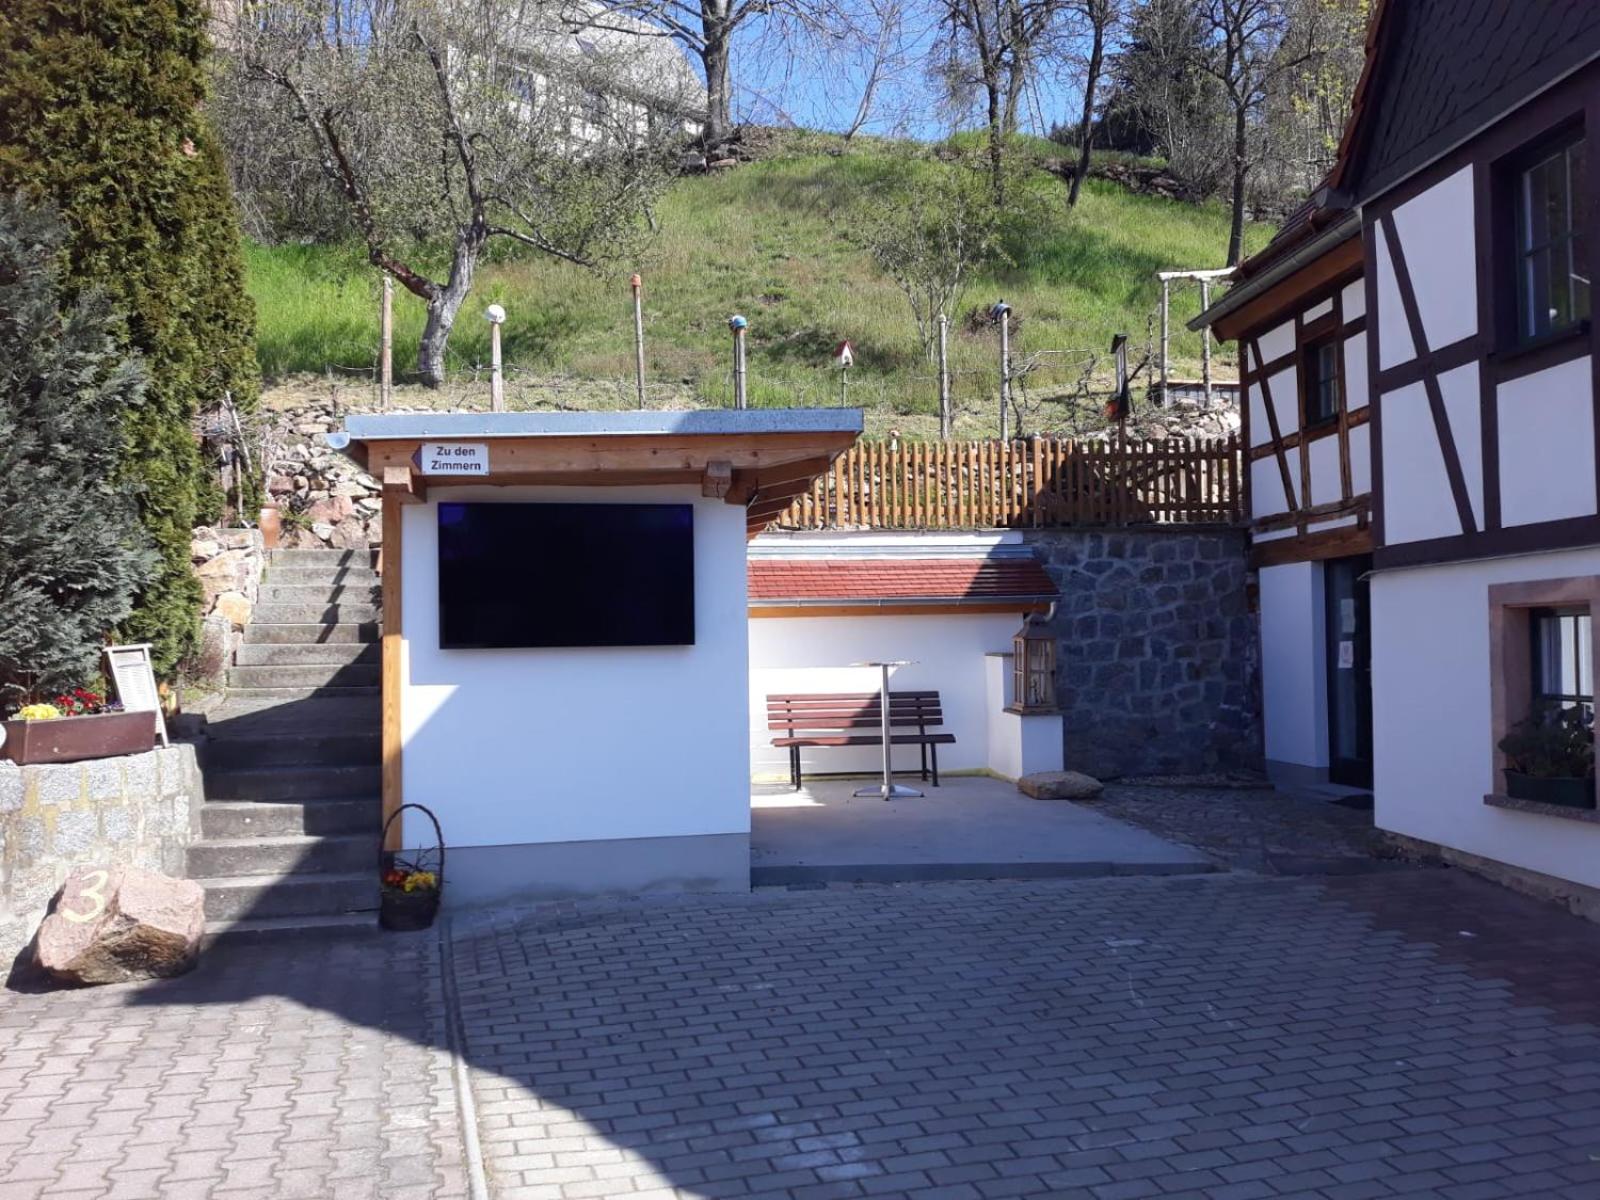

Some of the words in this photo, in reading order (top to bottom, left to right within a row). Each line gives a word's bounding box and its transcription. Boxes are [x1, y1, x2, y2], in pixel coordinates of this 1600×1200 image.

[436, 446, 451, 456] Zu
[454, 446, 475, 456] den
[431, 460, 481, 470] Zimmern
[61, 870, 109, 923] 3
